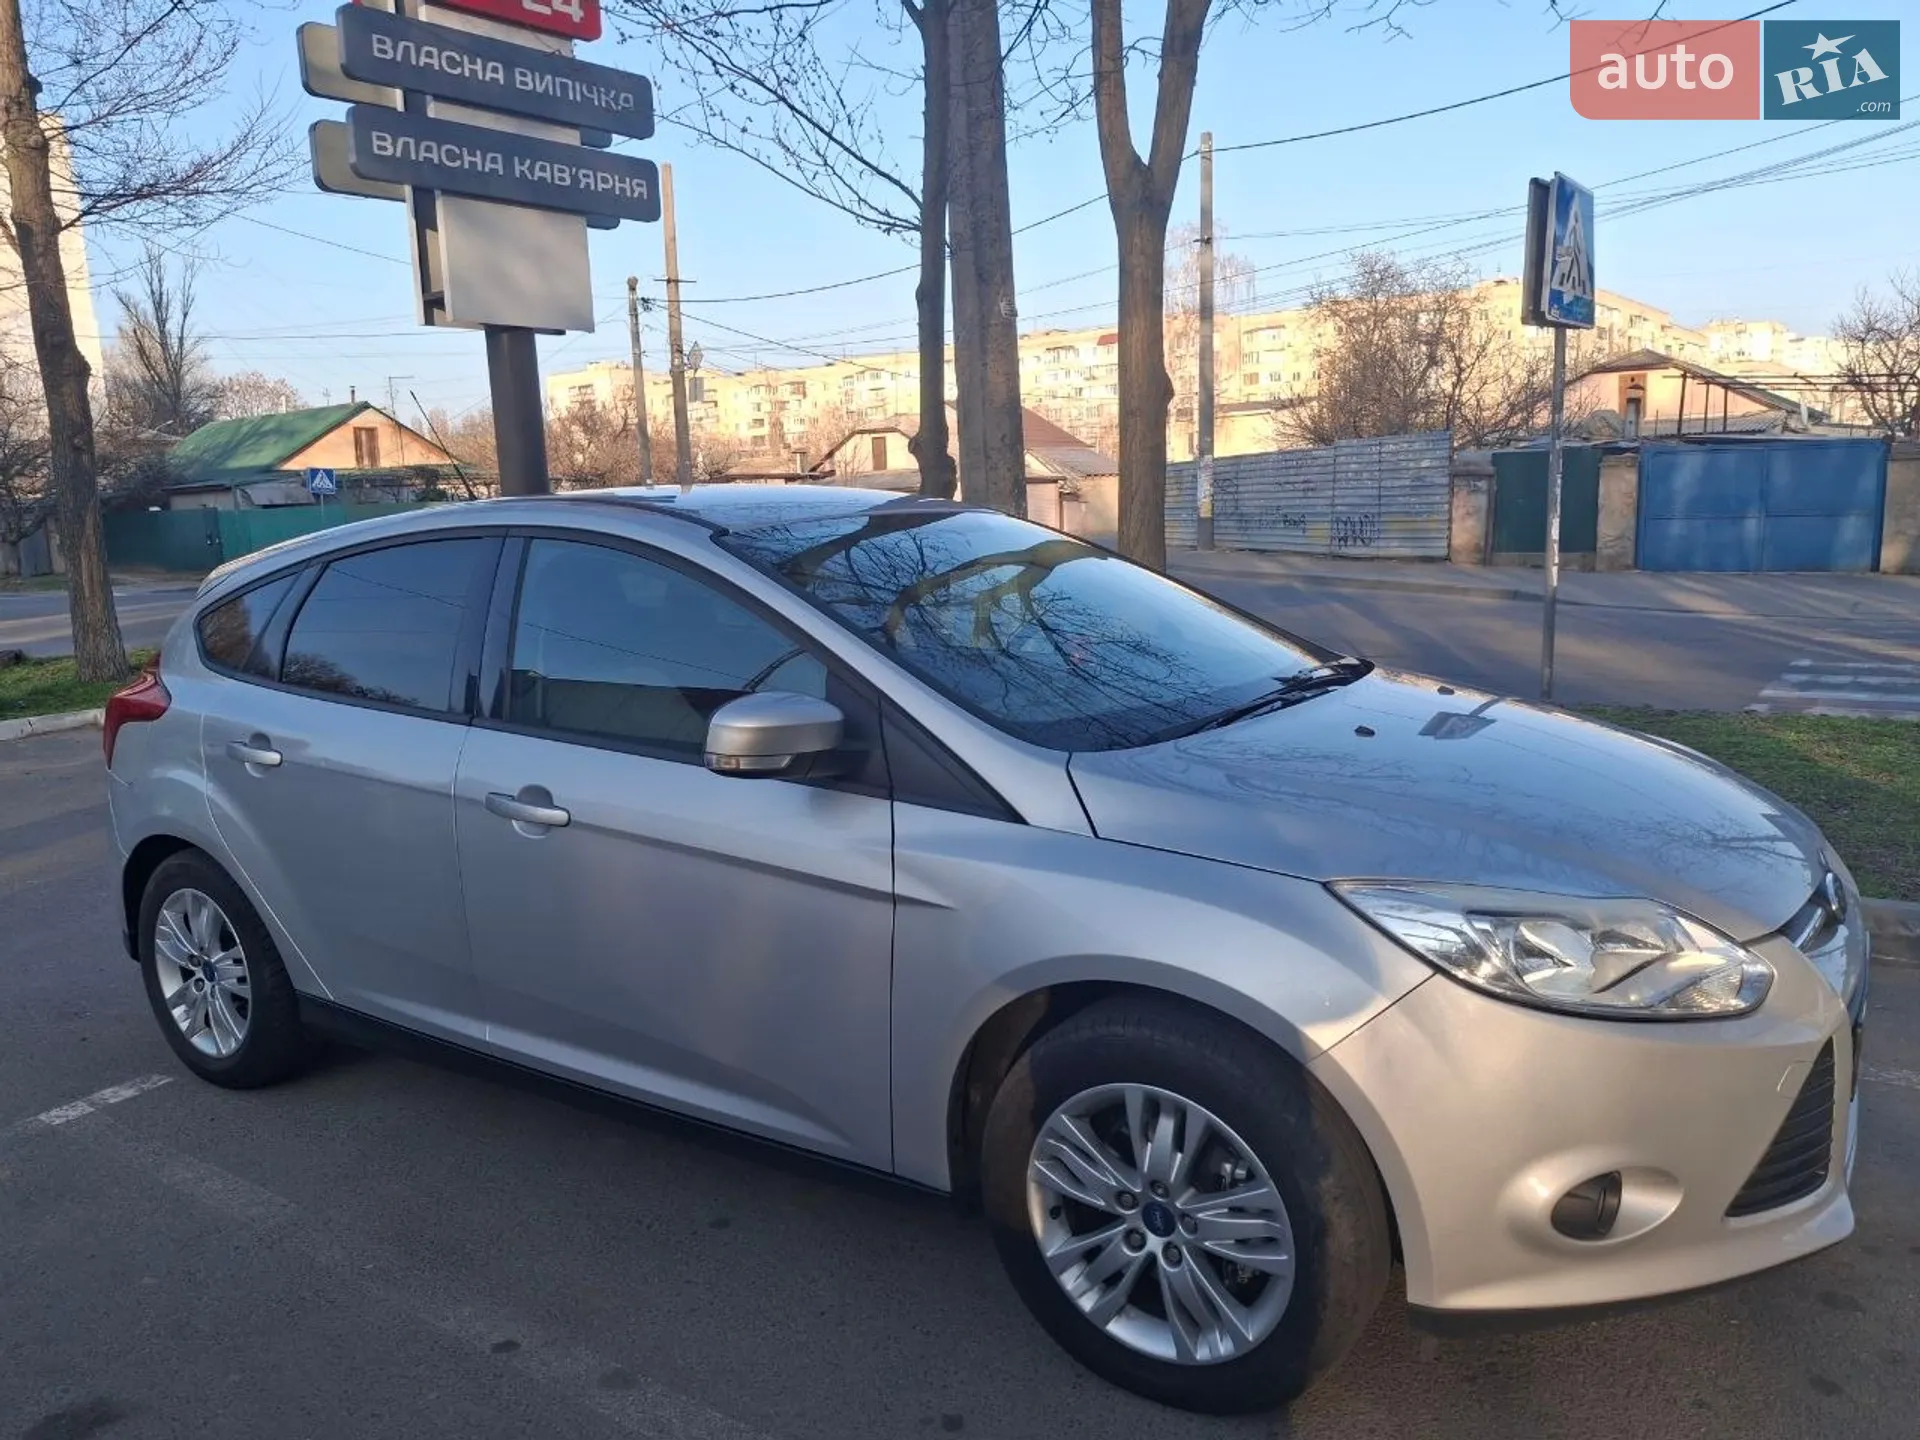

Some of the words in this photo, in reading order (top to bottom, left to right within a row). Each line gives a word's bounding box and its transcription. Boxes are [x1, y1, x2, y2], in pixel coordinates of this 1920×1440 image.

[371, 33, 504, 85] ВЛАСНА
[514, 67, 635, 111] ВИПІЧКА
[371, 130, 504, 176] ВЛАСНА
